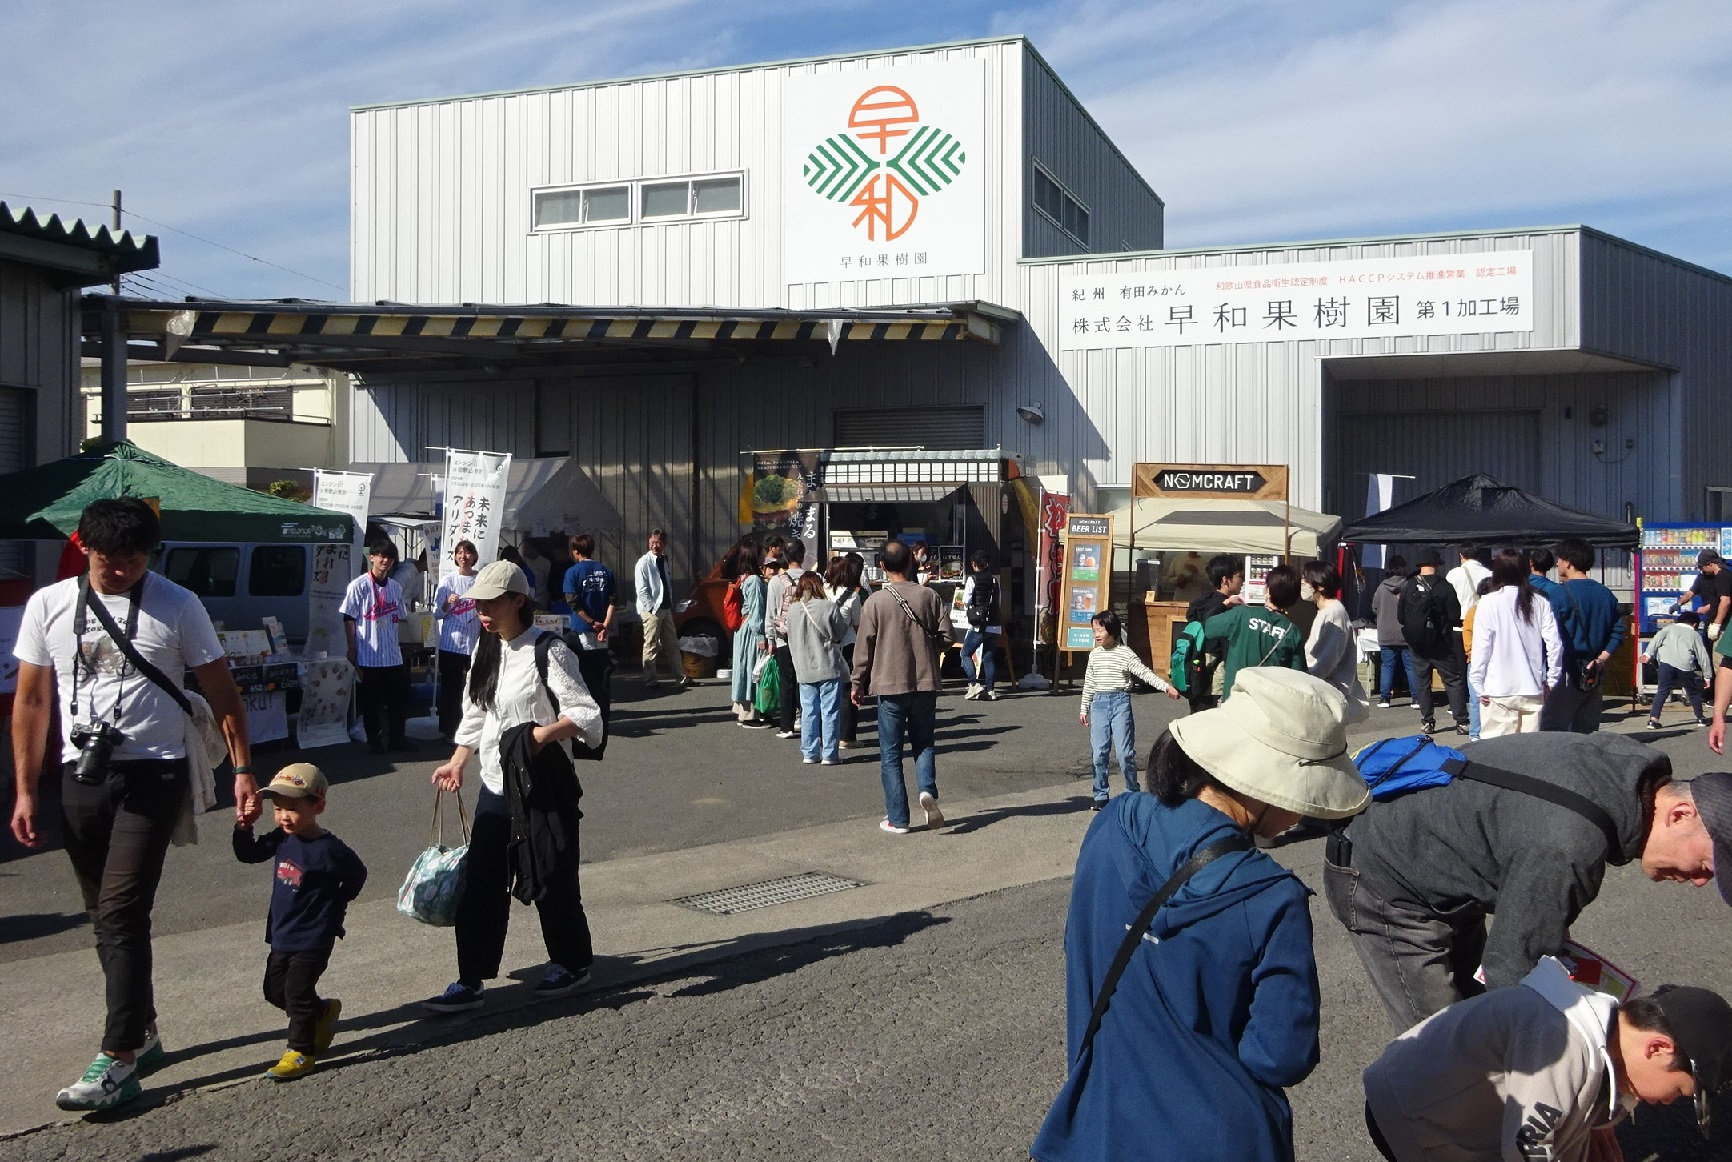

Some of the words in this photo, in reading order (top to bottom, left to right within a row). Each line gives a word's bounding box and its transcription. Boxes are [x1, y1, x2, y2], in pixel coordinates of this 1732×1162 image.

[839, 251, 928, 269] 早和果樹園
[1476, 265, 1517, 278] 認定工場
[1071, 286, 1106, 301] 紀州
[1119, 284, 1187, 299] 有田みかん
[1071, 314, 1154, 335] 株式会社
[1164, 294, 1400, 335] 早和果樹園
[1416, 296, 1520, 320] 第1加工場
[1163, 473, 1254, 490] NOMCRAFT
[803, 470, 817, 539] ままる
[461, 494, 476, 541] あつま
[474, 495, 491, 541] 未来に
[1071, 524, 1090, 533] BEER
